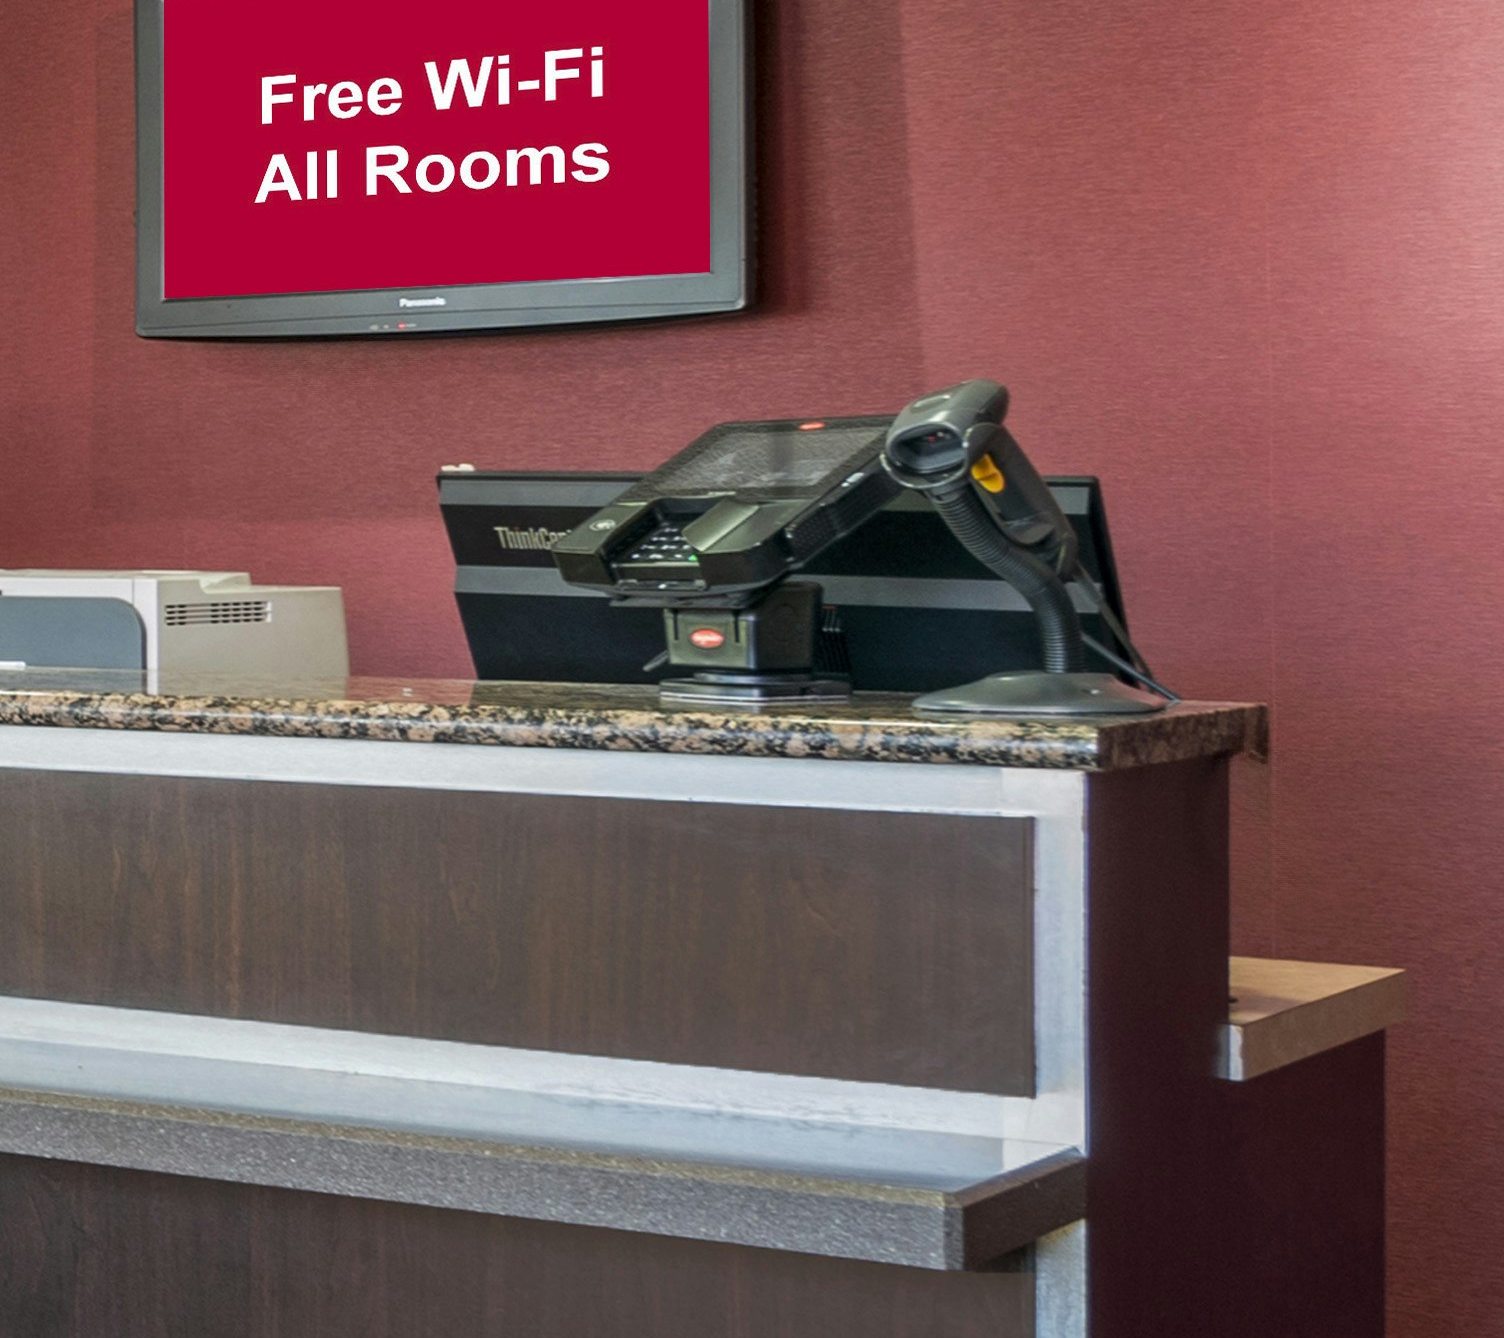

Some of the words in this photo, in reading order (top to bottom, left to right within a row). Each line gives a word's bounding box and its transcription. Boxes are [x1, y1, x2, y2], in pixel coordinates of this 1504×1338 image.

[261, 74, 403, 124] Free
[424, 46, 603, 110] Wi-Fi
[254, 150, 338, 203] All
[366, 143, 610, 196] Rooms
[493, 525, 573, 550] ThinkCe
